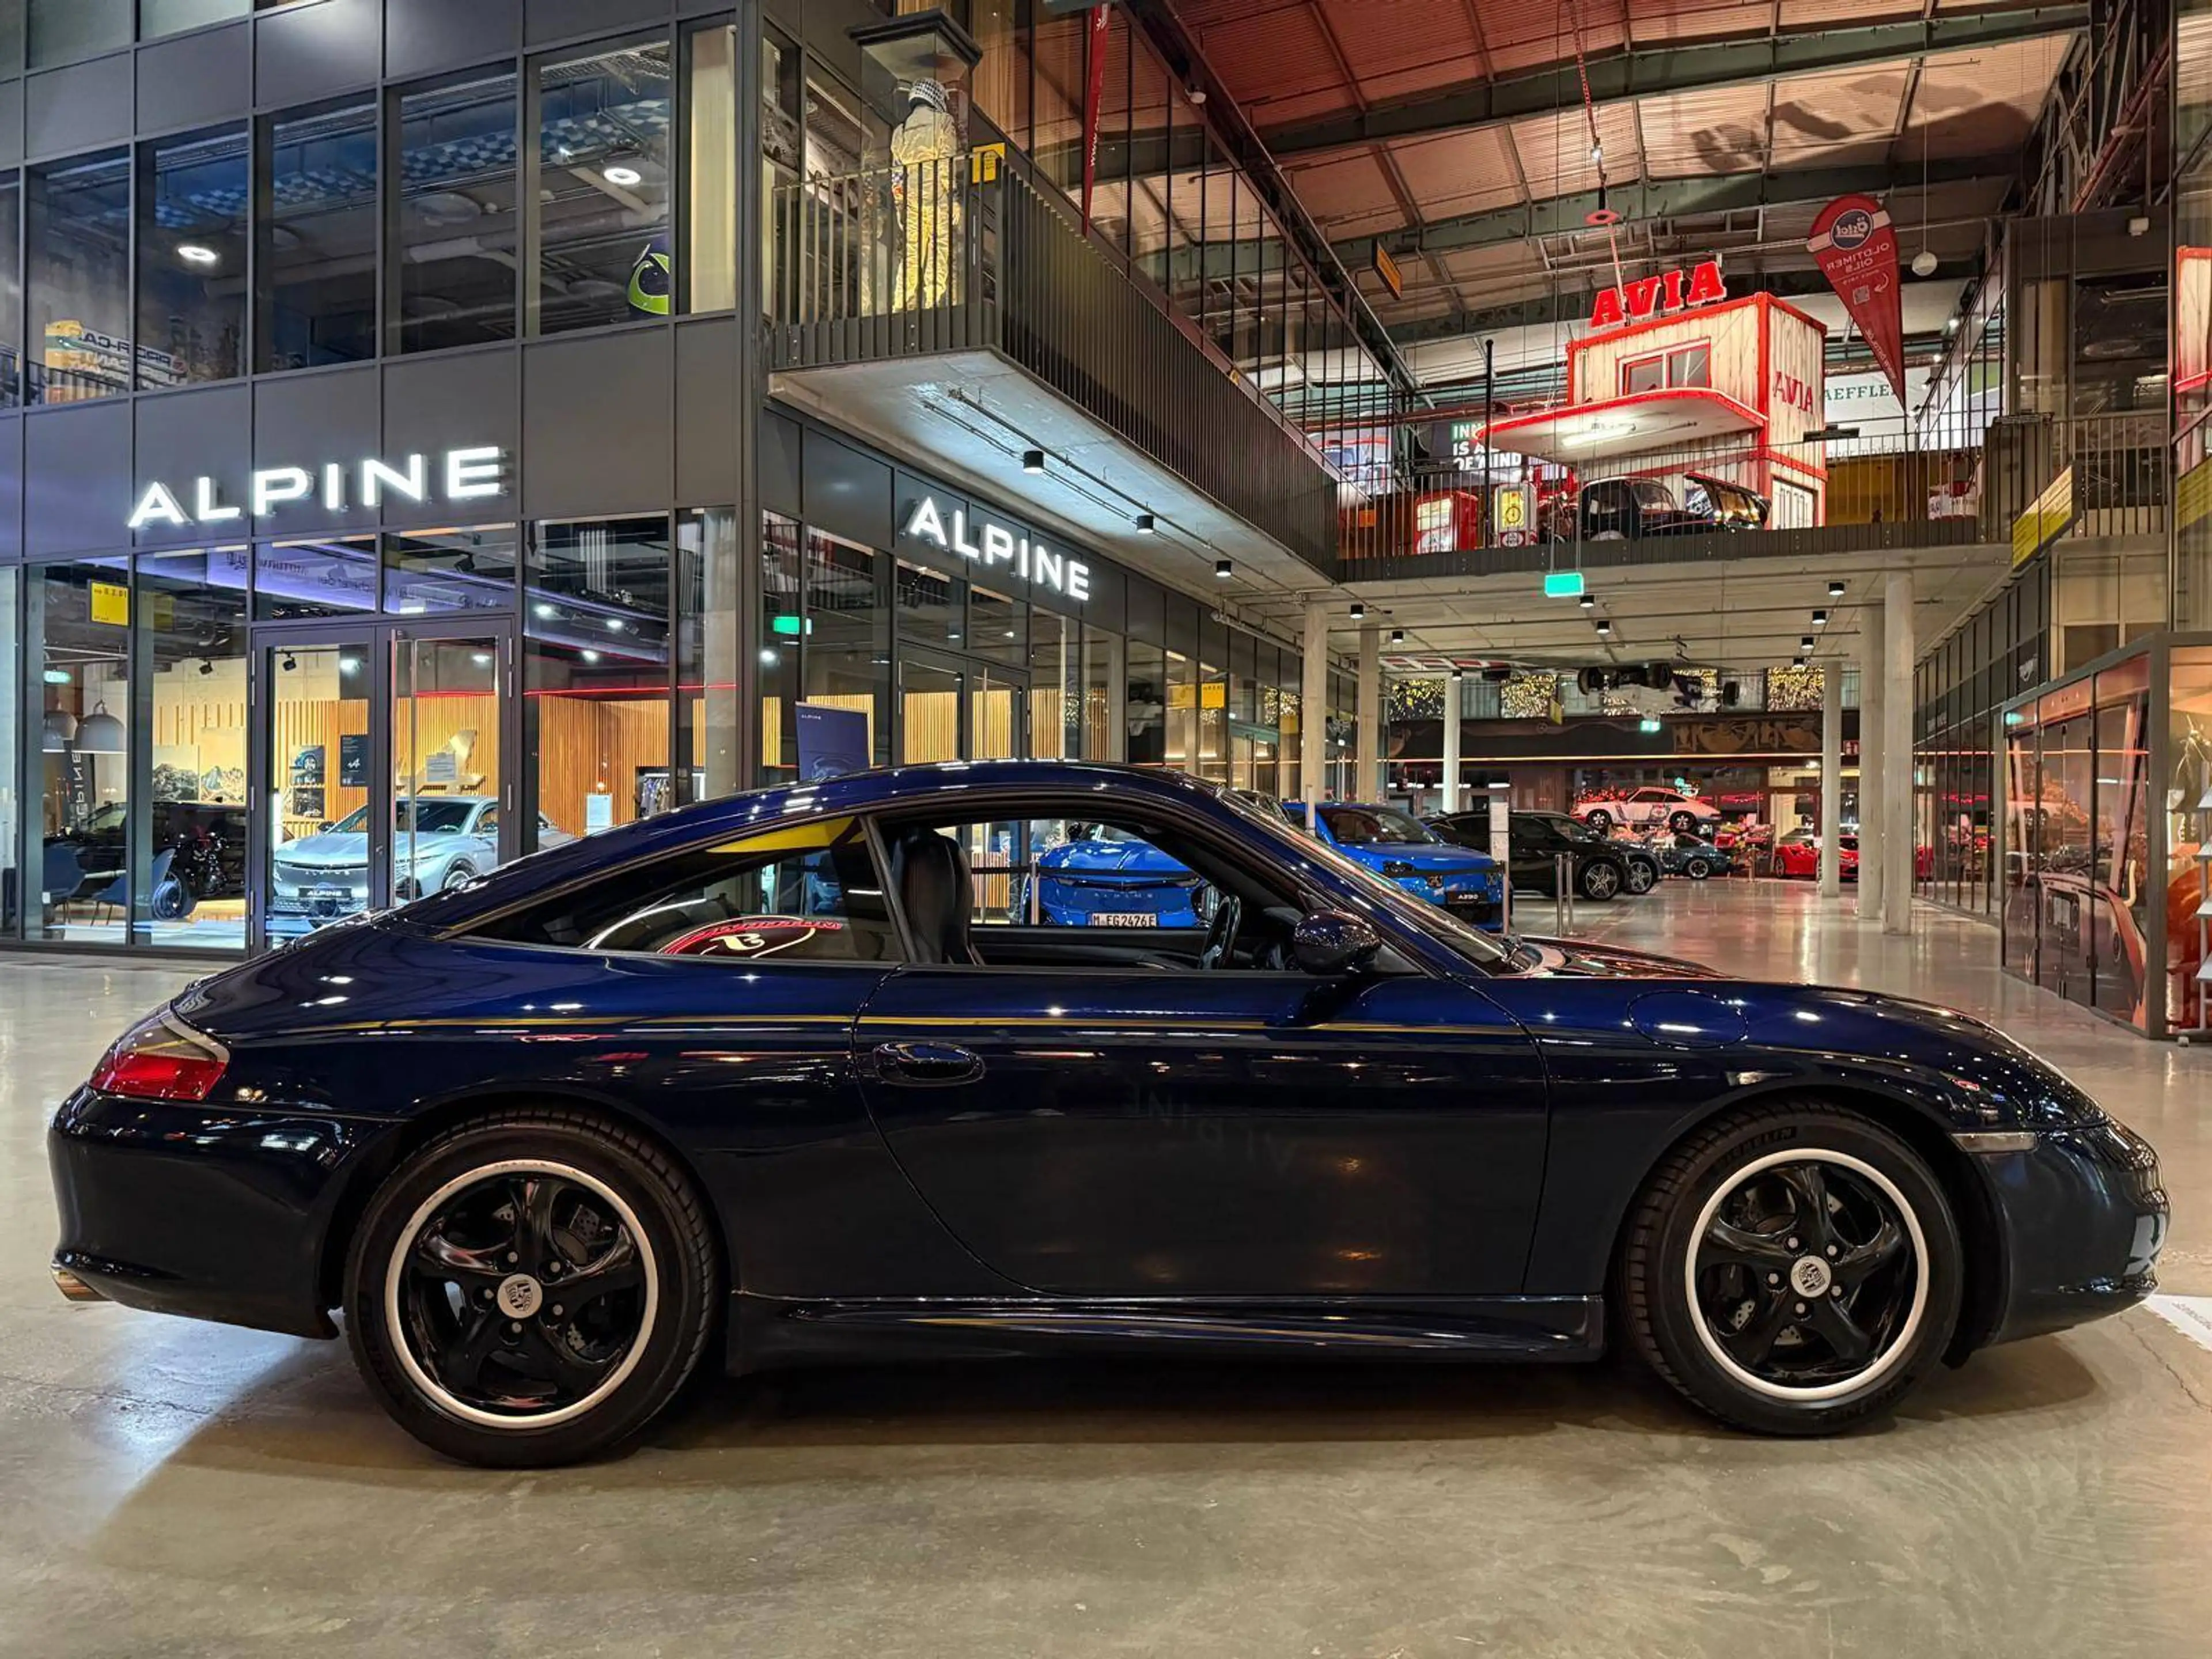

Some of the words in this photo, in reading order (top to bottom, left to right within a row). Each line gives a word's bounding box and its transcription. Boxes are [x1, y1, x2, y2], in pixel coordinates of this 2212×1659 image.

[1590, 261, 1727, 329] AVIA
[1773, 371, 1813, 415] AVIA
[128, 447, 499, 528] ALPINE
[910, 497, 1089, 601] ALPINE
